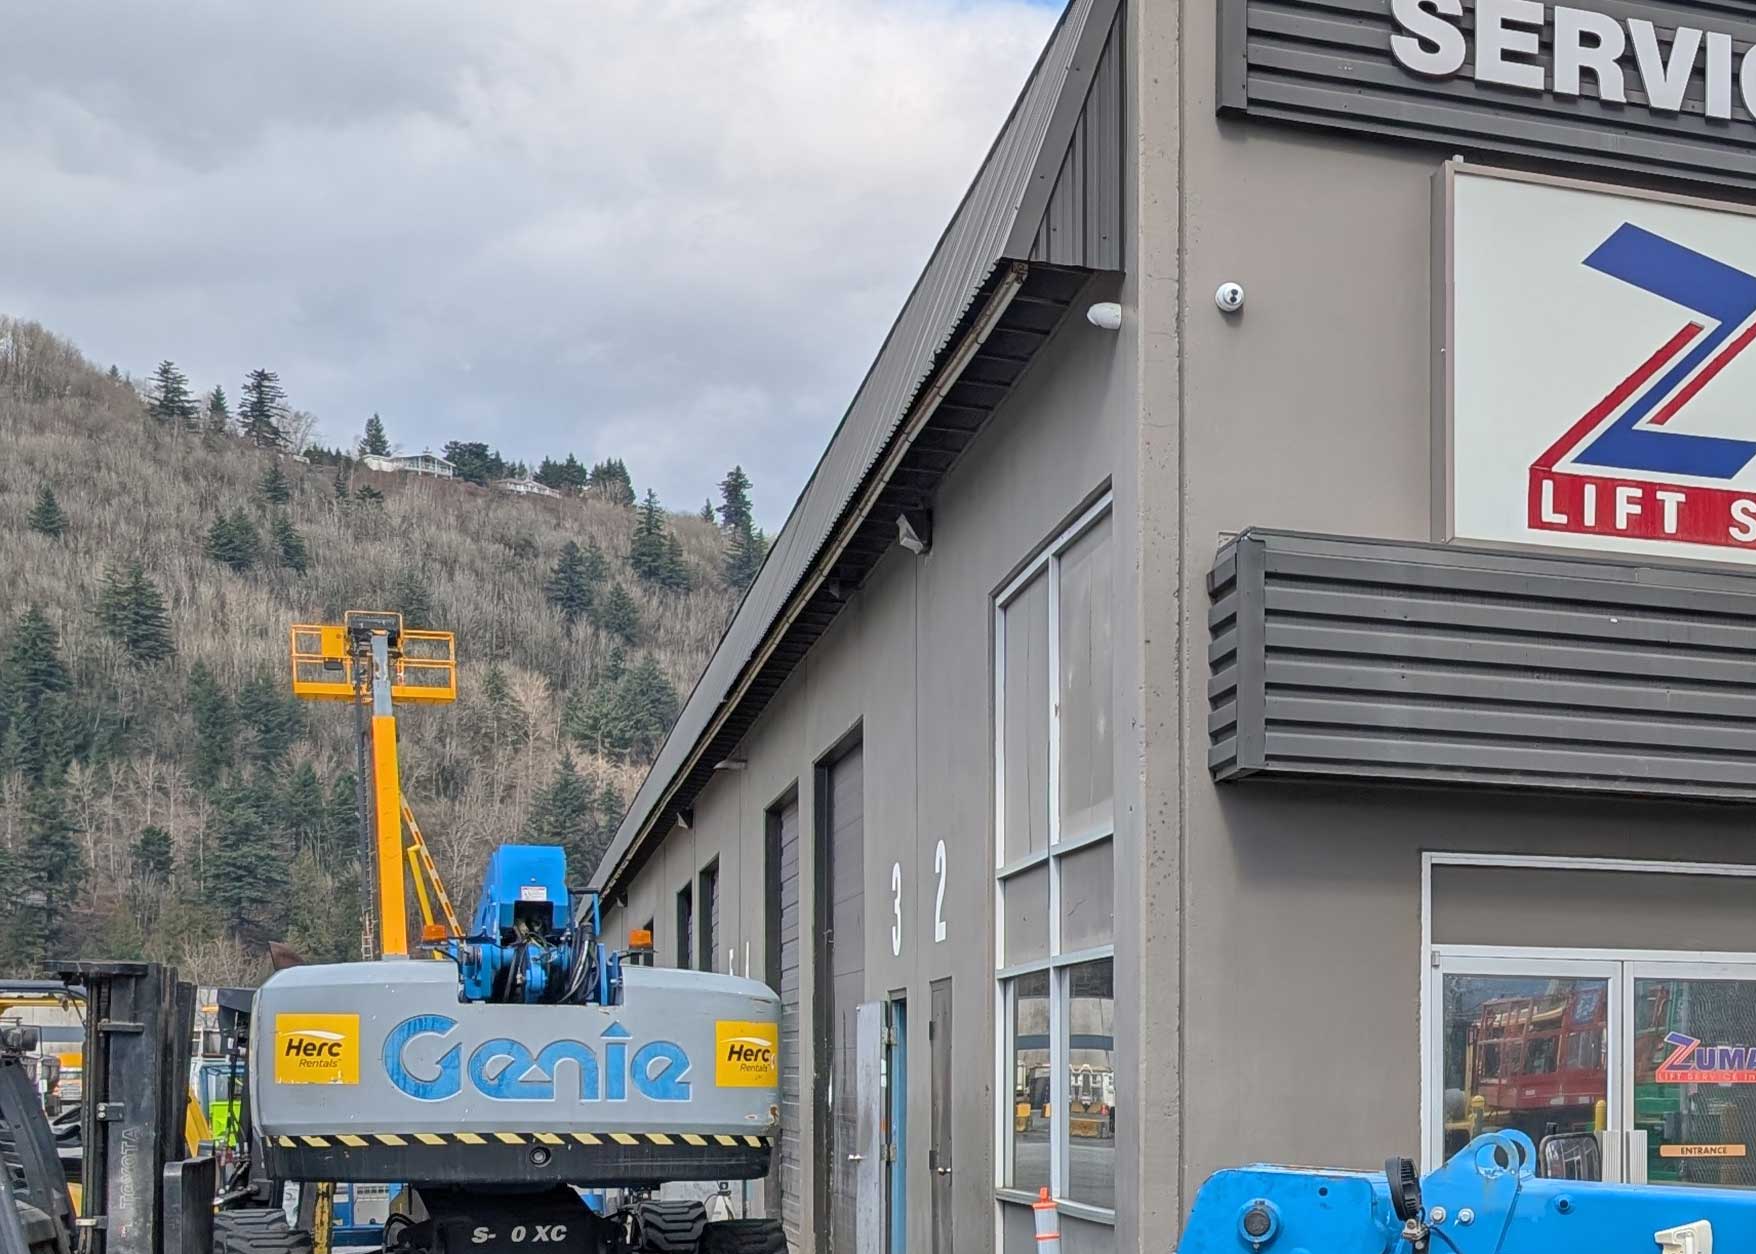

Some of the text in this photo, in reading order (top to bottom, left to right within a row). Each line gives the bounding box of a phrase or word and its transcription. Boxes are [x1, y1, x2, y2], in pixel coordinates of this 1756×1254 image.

[1540, 480, 1687, 533] LIFT
[934, 839, 947, 943] 2
[891, 862, 901, 957] 3
[285, 1038, 343, 1058] Herc
[727, 1043, 771, 1062] Herc
[298, 1057, 339, 1069] Rentals
[382, 1013, 692, 1104] Genie
[739, 1062, 769, 1073] Rentals
[1659, 1073, 1681, 1081] LIFT
[1688, 1073, 1737, 1081] SERVICE
[1680, 1146, 1728, 1155] ENTRANCE
[119, 1127, 142, 1209] TOYOTA
